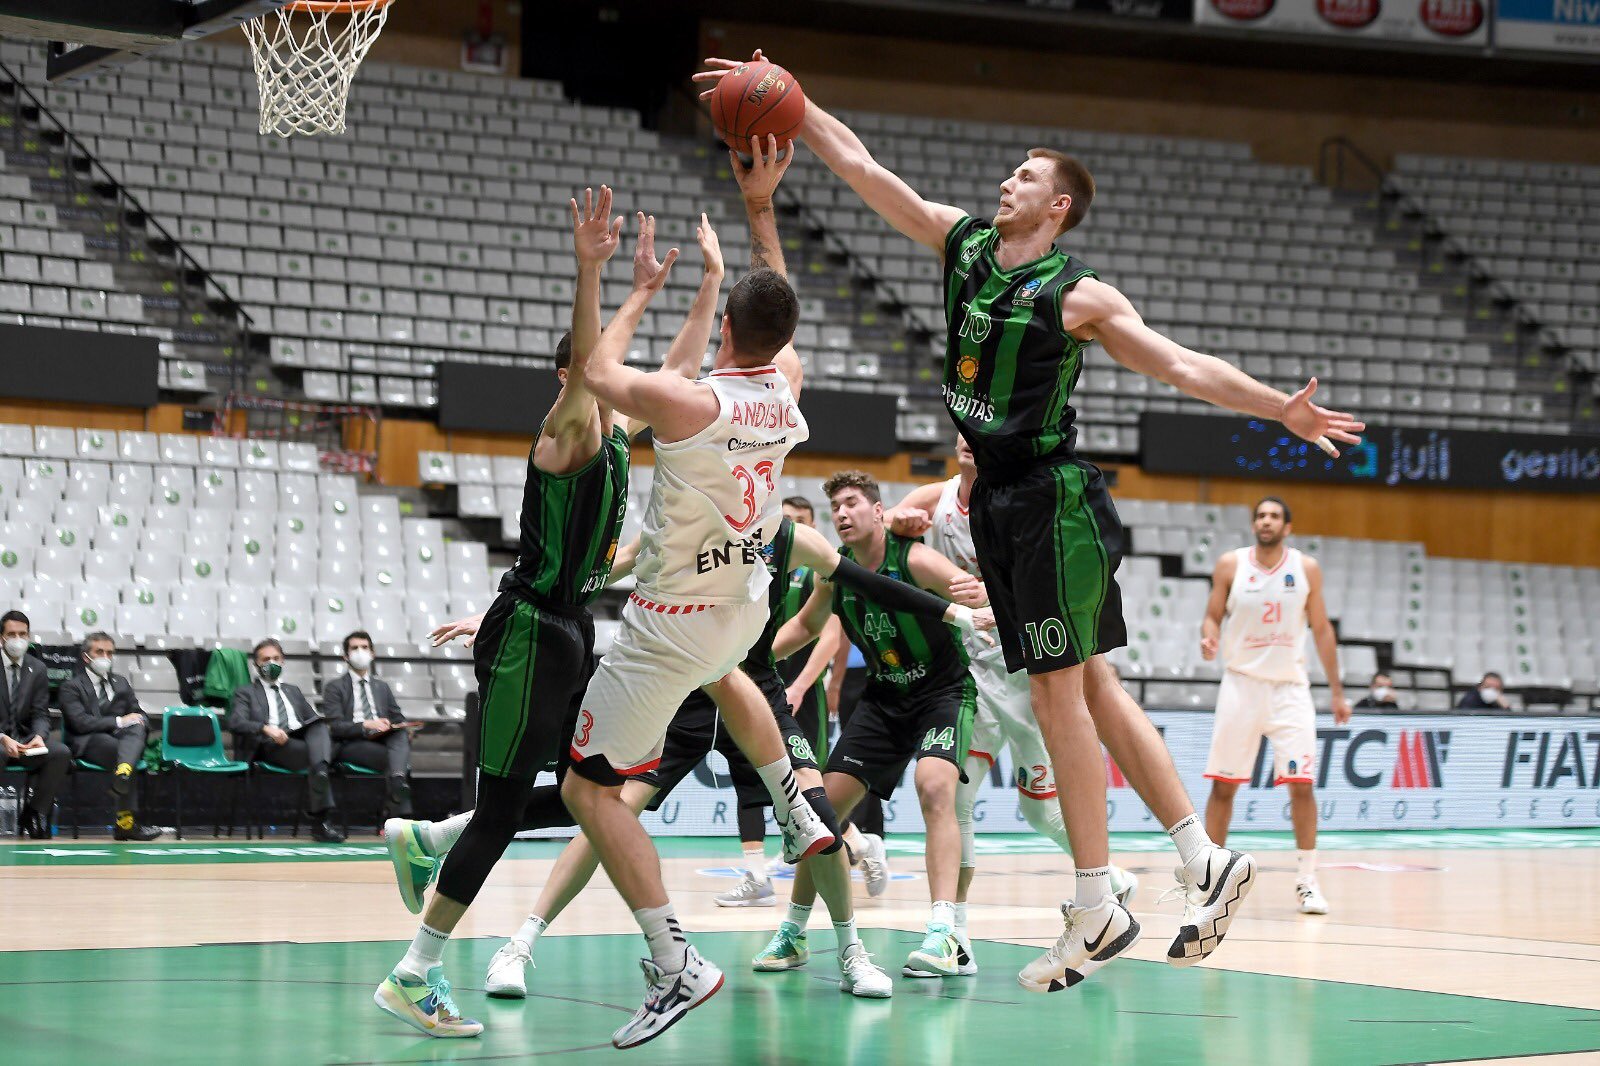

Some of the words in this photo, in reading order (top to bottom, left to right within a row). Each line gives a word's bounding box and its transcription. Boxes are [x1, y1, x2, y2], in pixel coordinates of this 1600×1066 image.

[958, 302, 992, 343] 10
[863, 612, 897, 642] 44
[1262, 601, 1283, 624] 21
[1025, 617, 1068, 660] 10
[920, 726, 955, 751] 44
